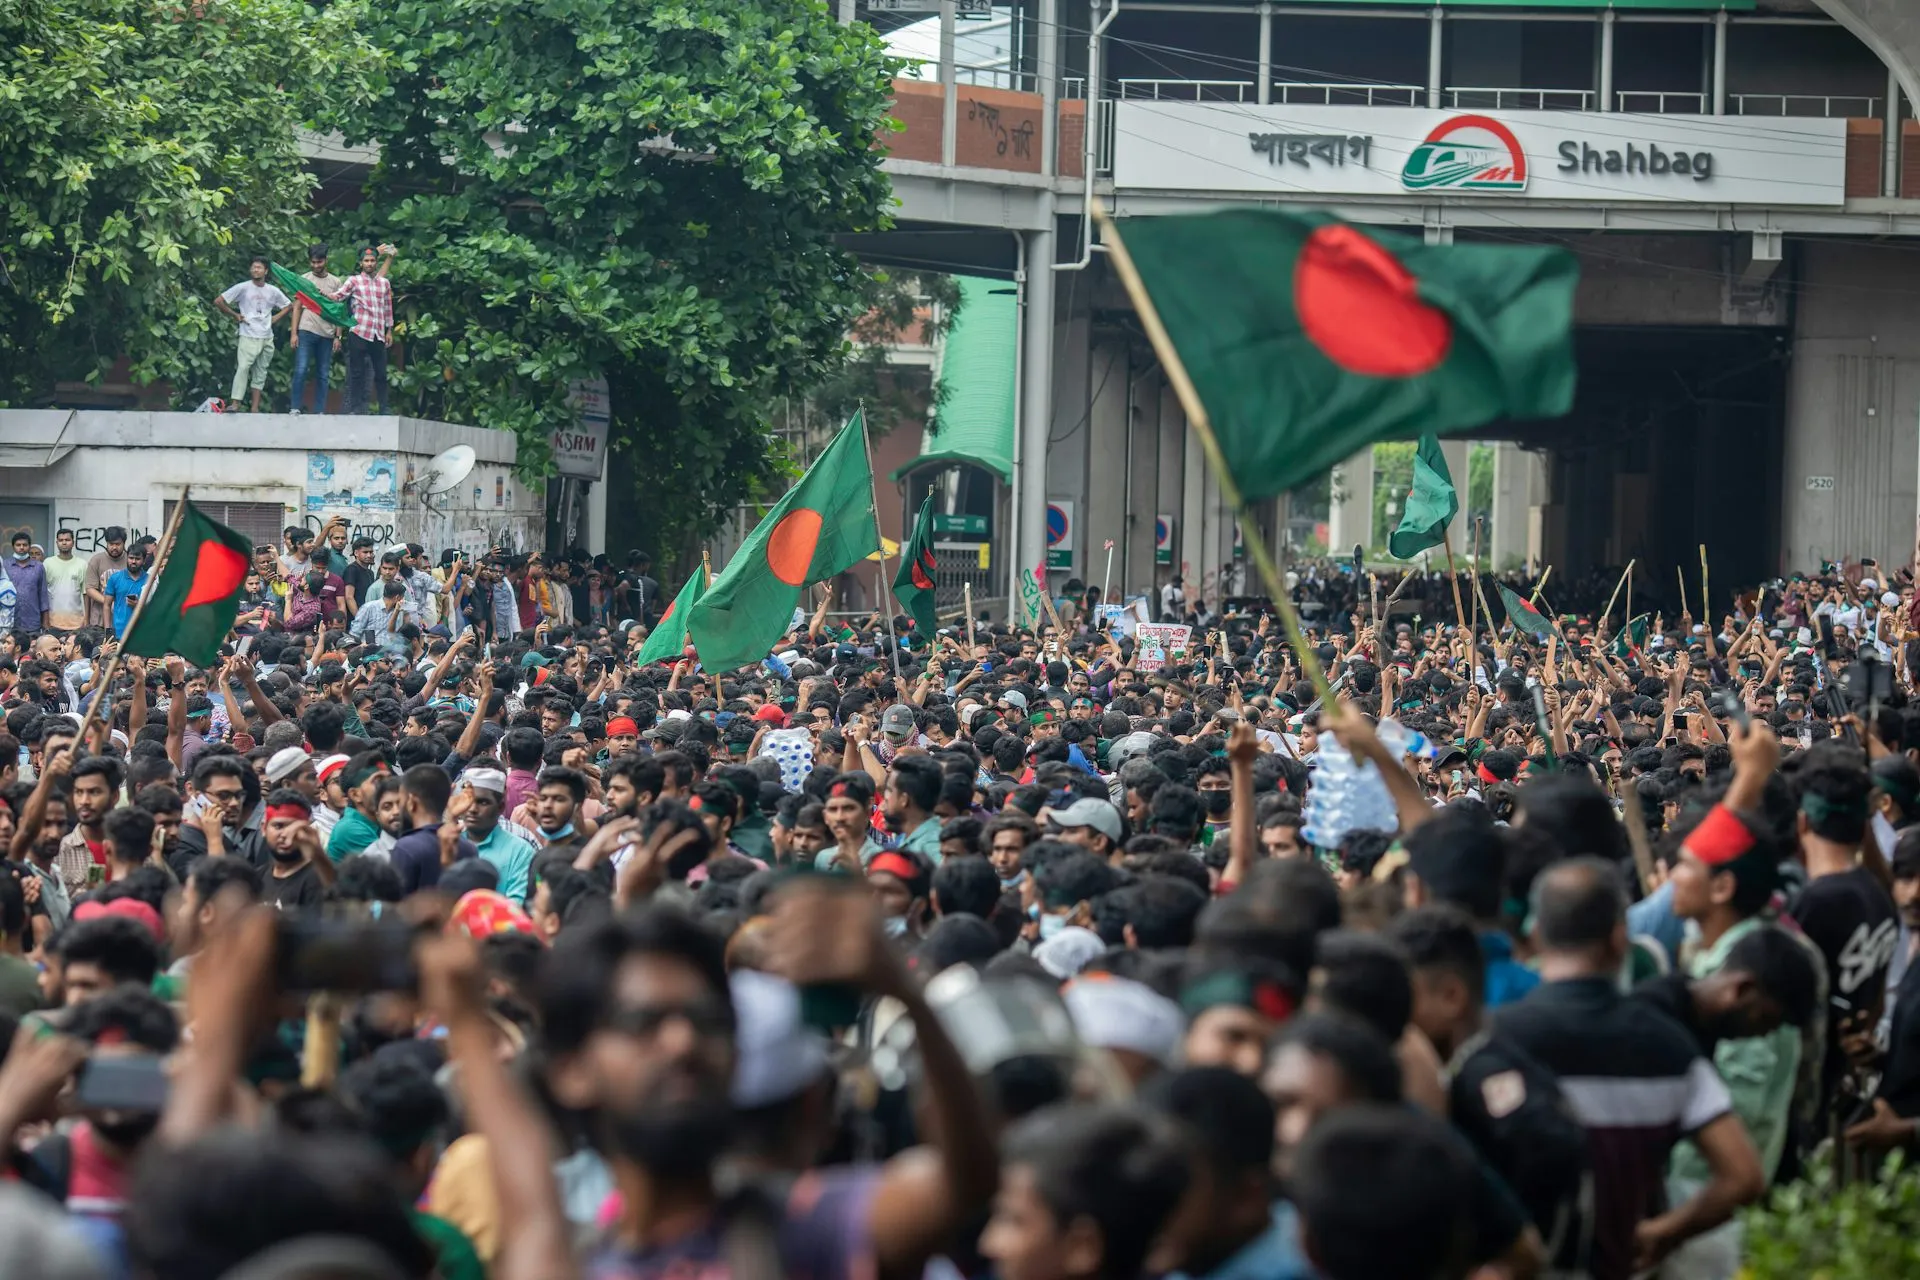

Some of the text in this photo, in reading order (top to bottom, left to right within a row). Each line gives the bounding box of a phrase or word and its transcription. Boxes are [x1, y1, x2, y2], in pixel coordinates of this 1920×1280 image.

[1248, 131, 1373, 169] শাহবাগ
[1557, 141, 1713, 181] Shahbag
[555, 432, 596, 452] KSRM
